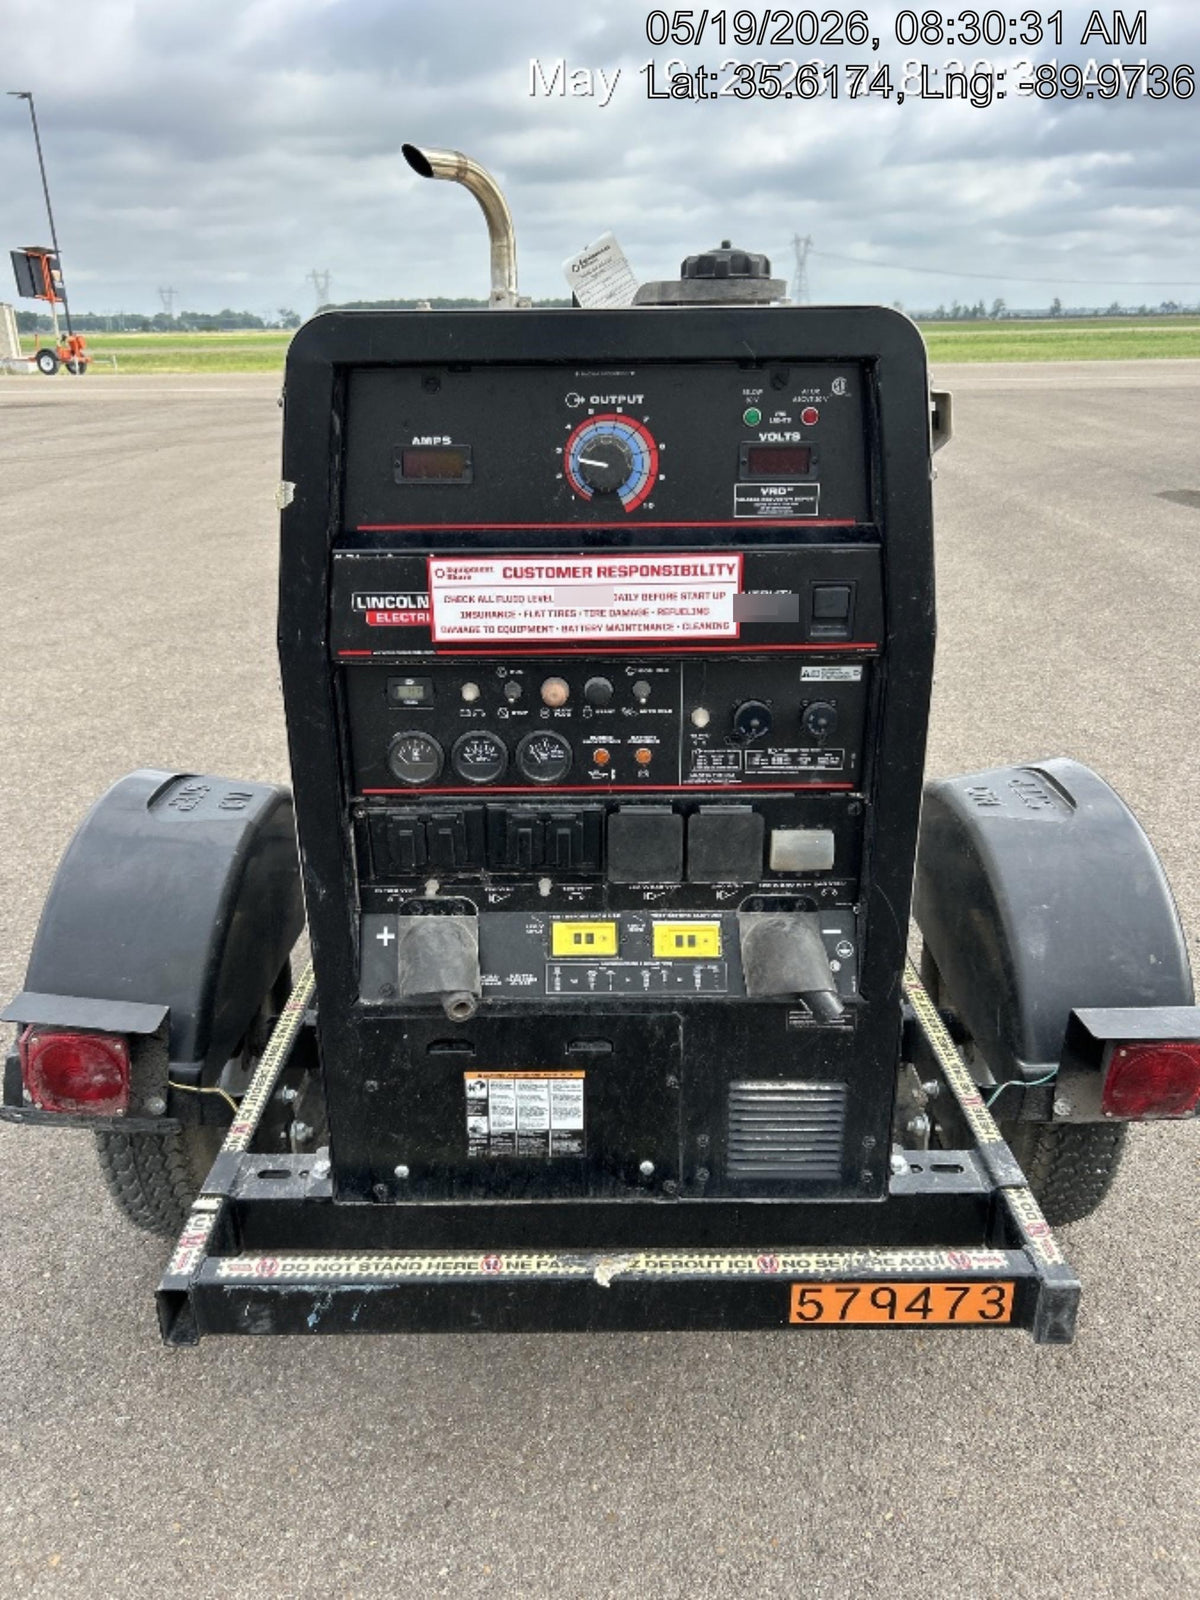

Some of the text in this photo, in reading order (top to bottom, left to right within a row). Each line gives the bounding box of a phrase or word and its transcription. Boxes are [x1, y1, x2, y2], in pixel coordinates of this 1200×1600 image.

[589, 394, 645, 405] OUTPUT
[411, 435, 453, 446] AMPS
[758, 431, 802, 442] VOLTS
[501, 562, 736, 579] CUSTOMER RESPONSIBILITY
[356, 595, 430, 609] LINCOLN
[443, 595, 475, 603] CHECK
[477, 595, 495, 603] ALL
[495, 594, 525, 603] FLUID
[641, 593, 678, 601] BEFORE
[680, 592, 711, 600] START
[712, 592, 726, 600] UP
[376, 612, 430, 623] ELECTRI
[460, 607, 710, 619] INSURANCE FLAT TIRES TIRE DAMAGE REFUELING
[440, 622, 730, 634] DAMAGE TO EQUIPMENT BATTERY MAINTENANCE CLEANING
[281, 1260, 479, 1272] DO NOT STAND HERE
[505, 1259, 533, 1270] NE
[728, 1259, 752, 1269] ICI
[782, 1259, 812, 1269] NO
[795, 1285, 1007, 1322] 579473
